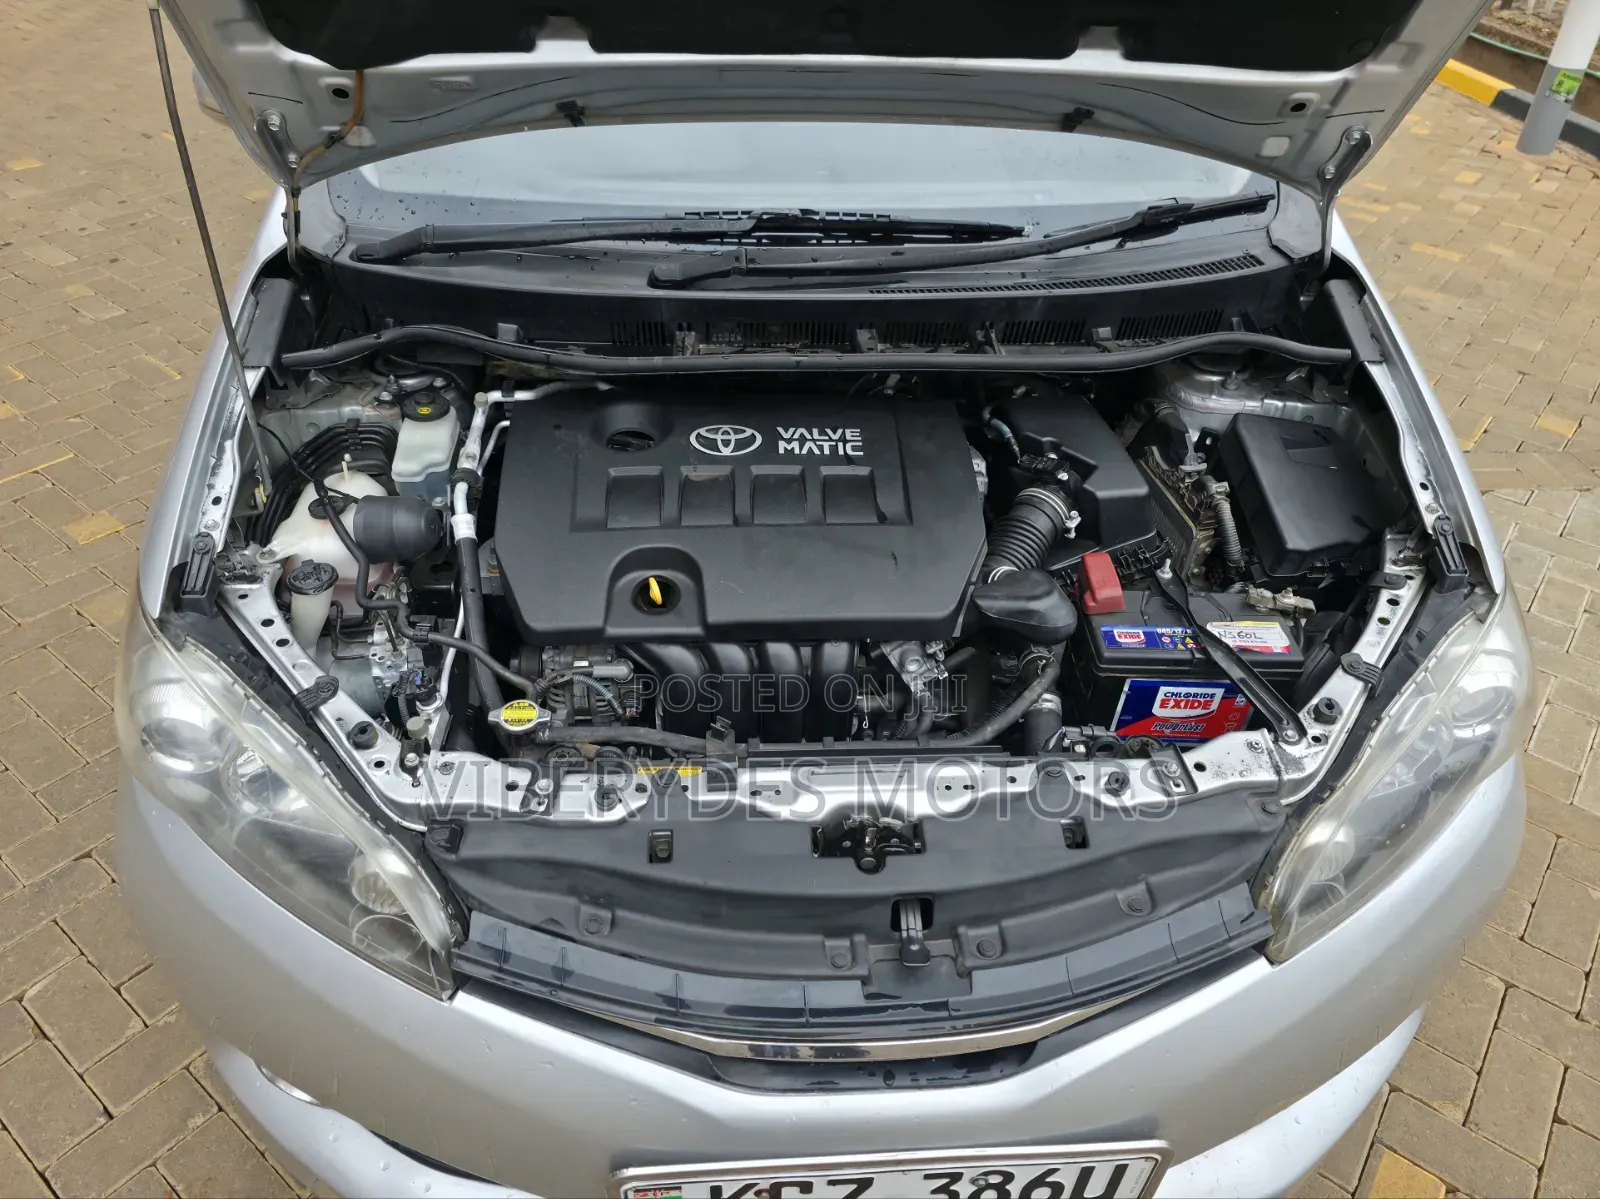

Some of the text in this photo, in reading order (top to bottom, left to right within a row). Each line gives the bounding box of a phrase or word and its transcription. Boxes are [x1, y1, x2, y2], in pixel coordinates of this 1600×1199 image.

[776, 426, 862, 440] VALVE
[778, 440, 864, 456] MATIC
[1117, 633, 1143, 641] EXIDE
[1163, 691, 1217, 700] CHLORIDE
[1158, 698, 1215, 711] EXIDE
[923, 1163, 1130, 1198] 386U
